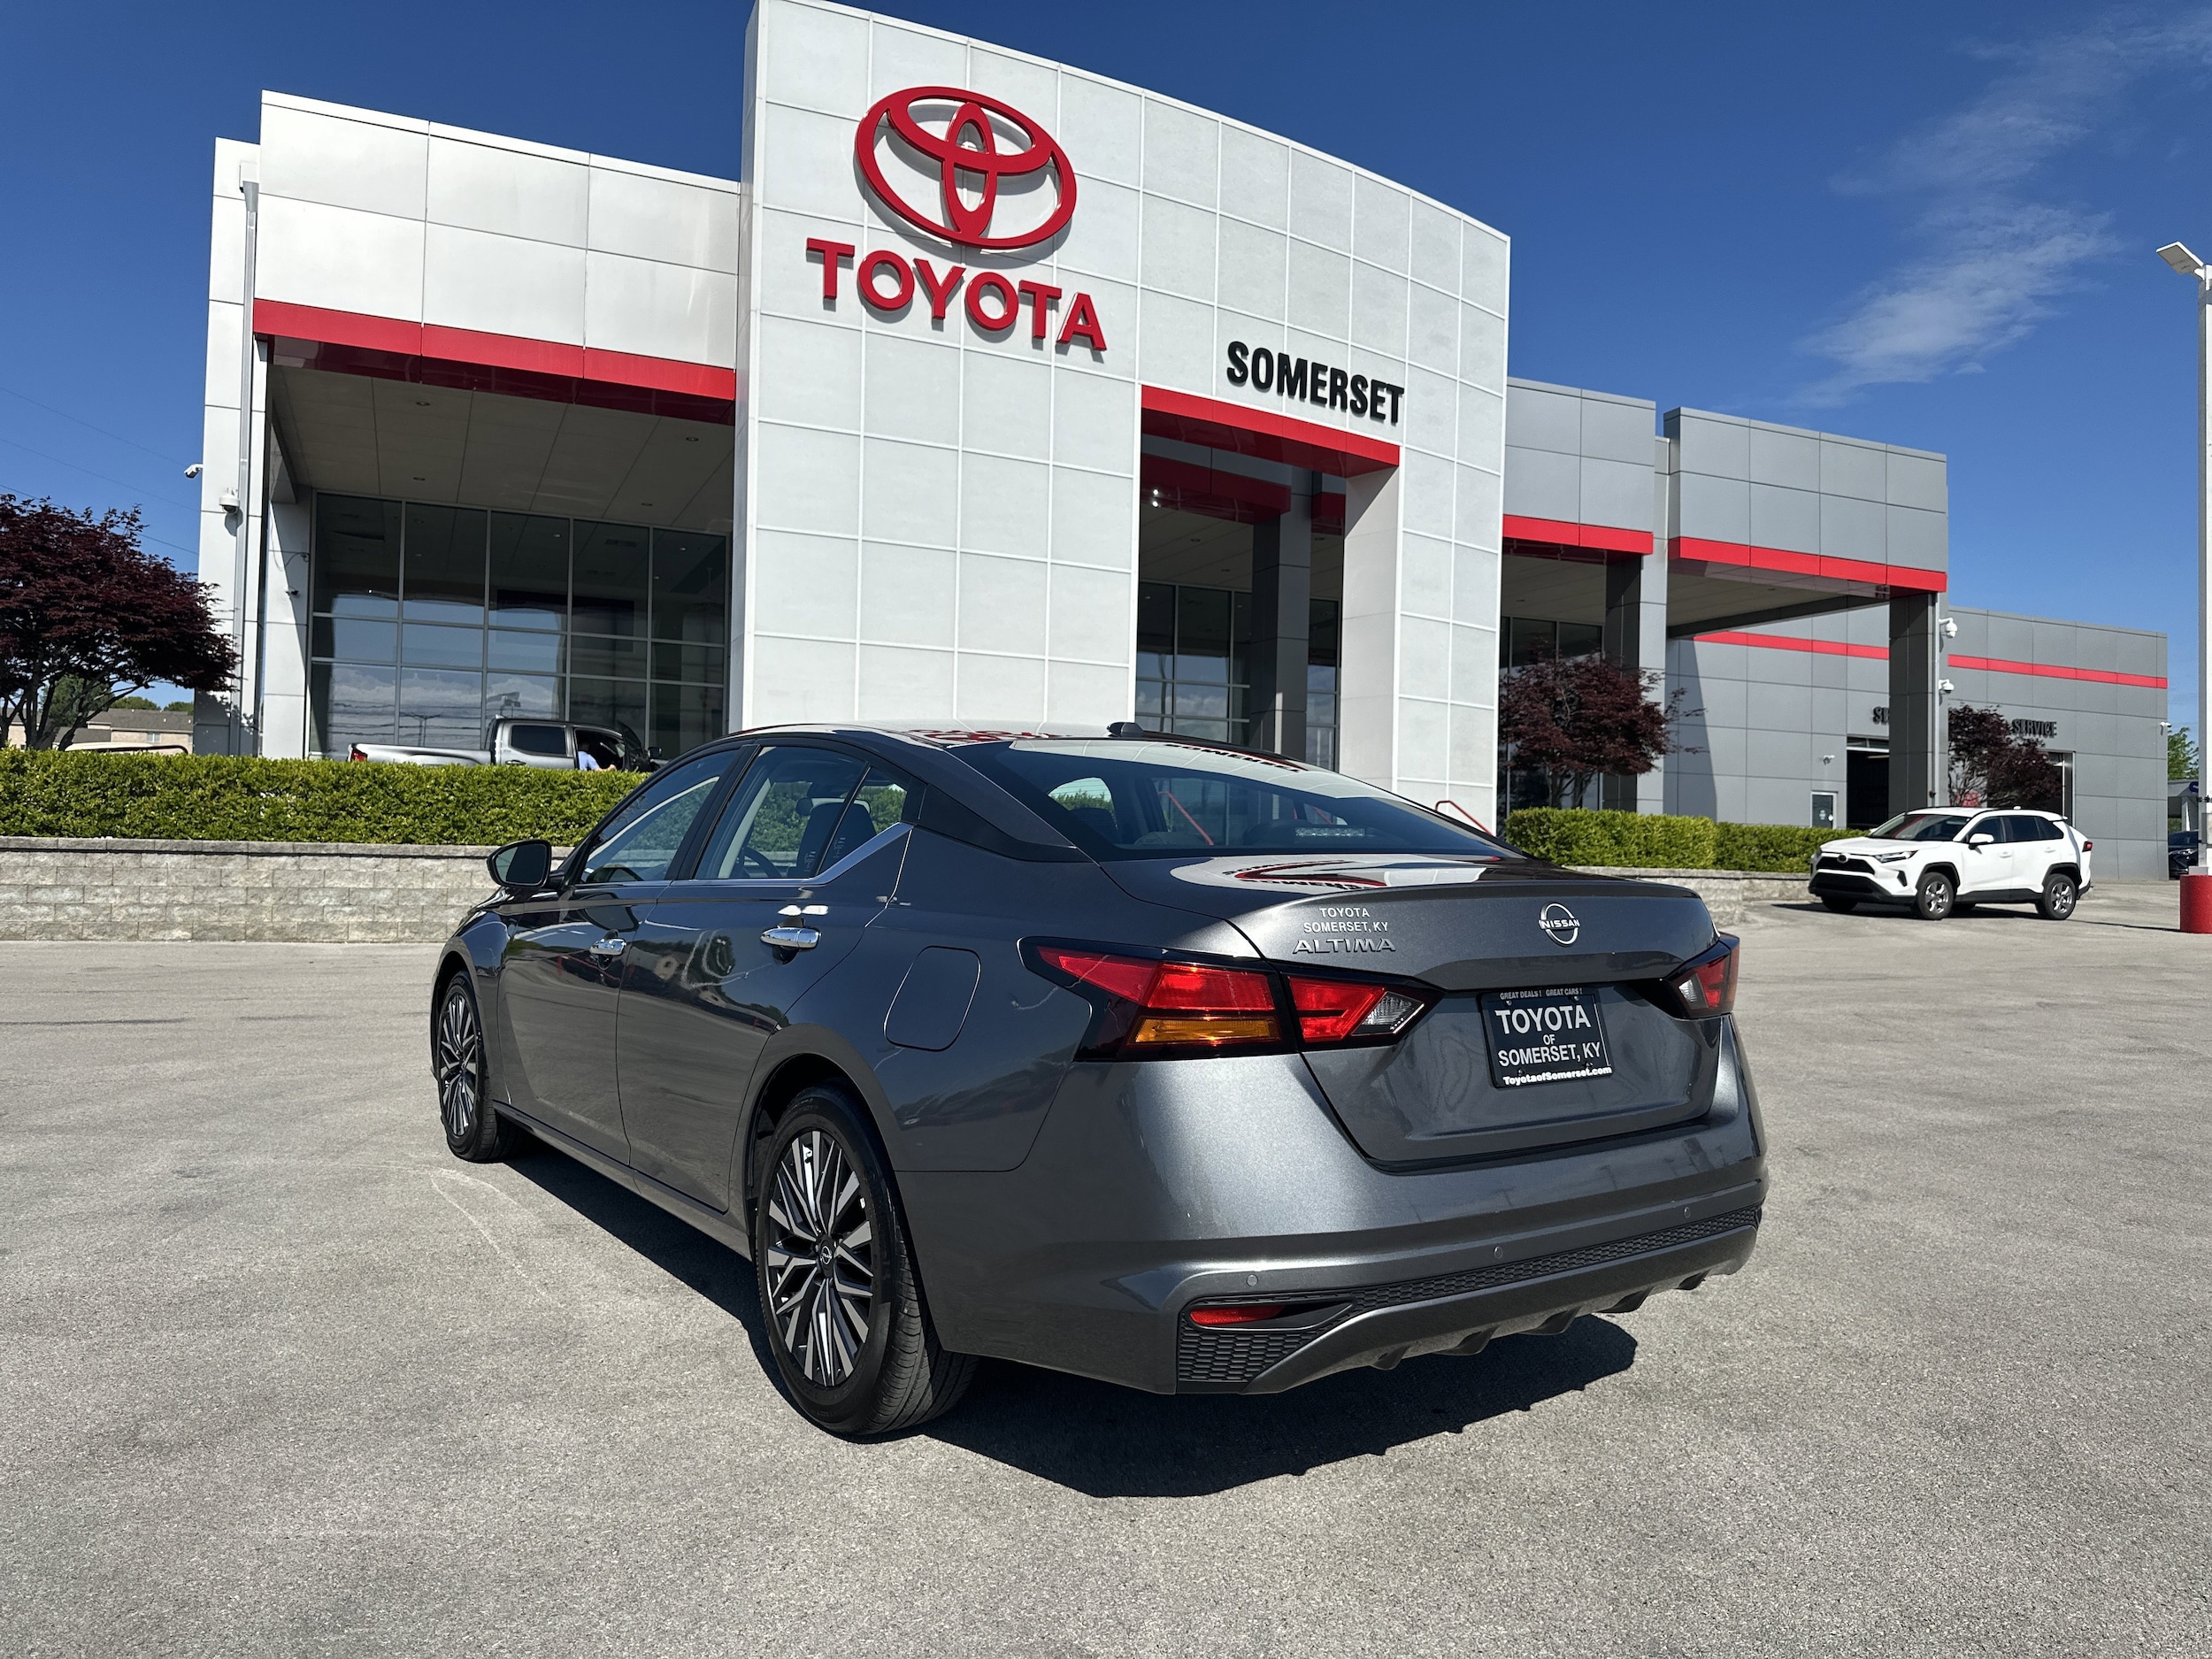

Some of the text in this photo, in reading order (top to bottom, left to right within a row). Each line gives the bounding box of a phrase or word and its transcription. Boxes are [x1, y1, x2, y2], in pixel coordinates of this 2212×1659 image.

[806, 238, 1107, 350] TOYOTA
[1226, 342, 1405, 424] SOMERSET
[2011, 718, 2057, 738] SERVICE
[1319, 907, 1371, 918] TOYOTA
[1303, 921, 1388, 933] SOMERSET, KY
[1539, 918, 1580, 929] NISSAN
[1293, 938, 1396, 954] ALTIMA
[1500, 991, 1519, 1000] GREAT
[1546, 988, 1563, 997] GREAT
[1494, 1004, 1592, 1034] TOYOTA
[1543, 1034, 1556, 1045] OF
[1498, 1041, 1601, 1067] SOMERSET, KY
[1503, 1066, 1612, 1087] ToyotaofSomerset.com
